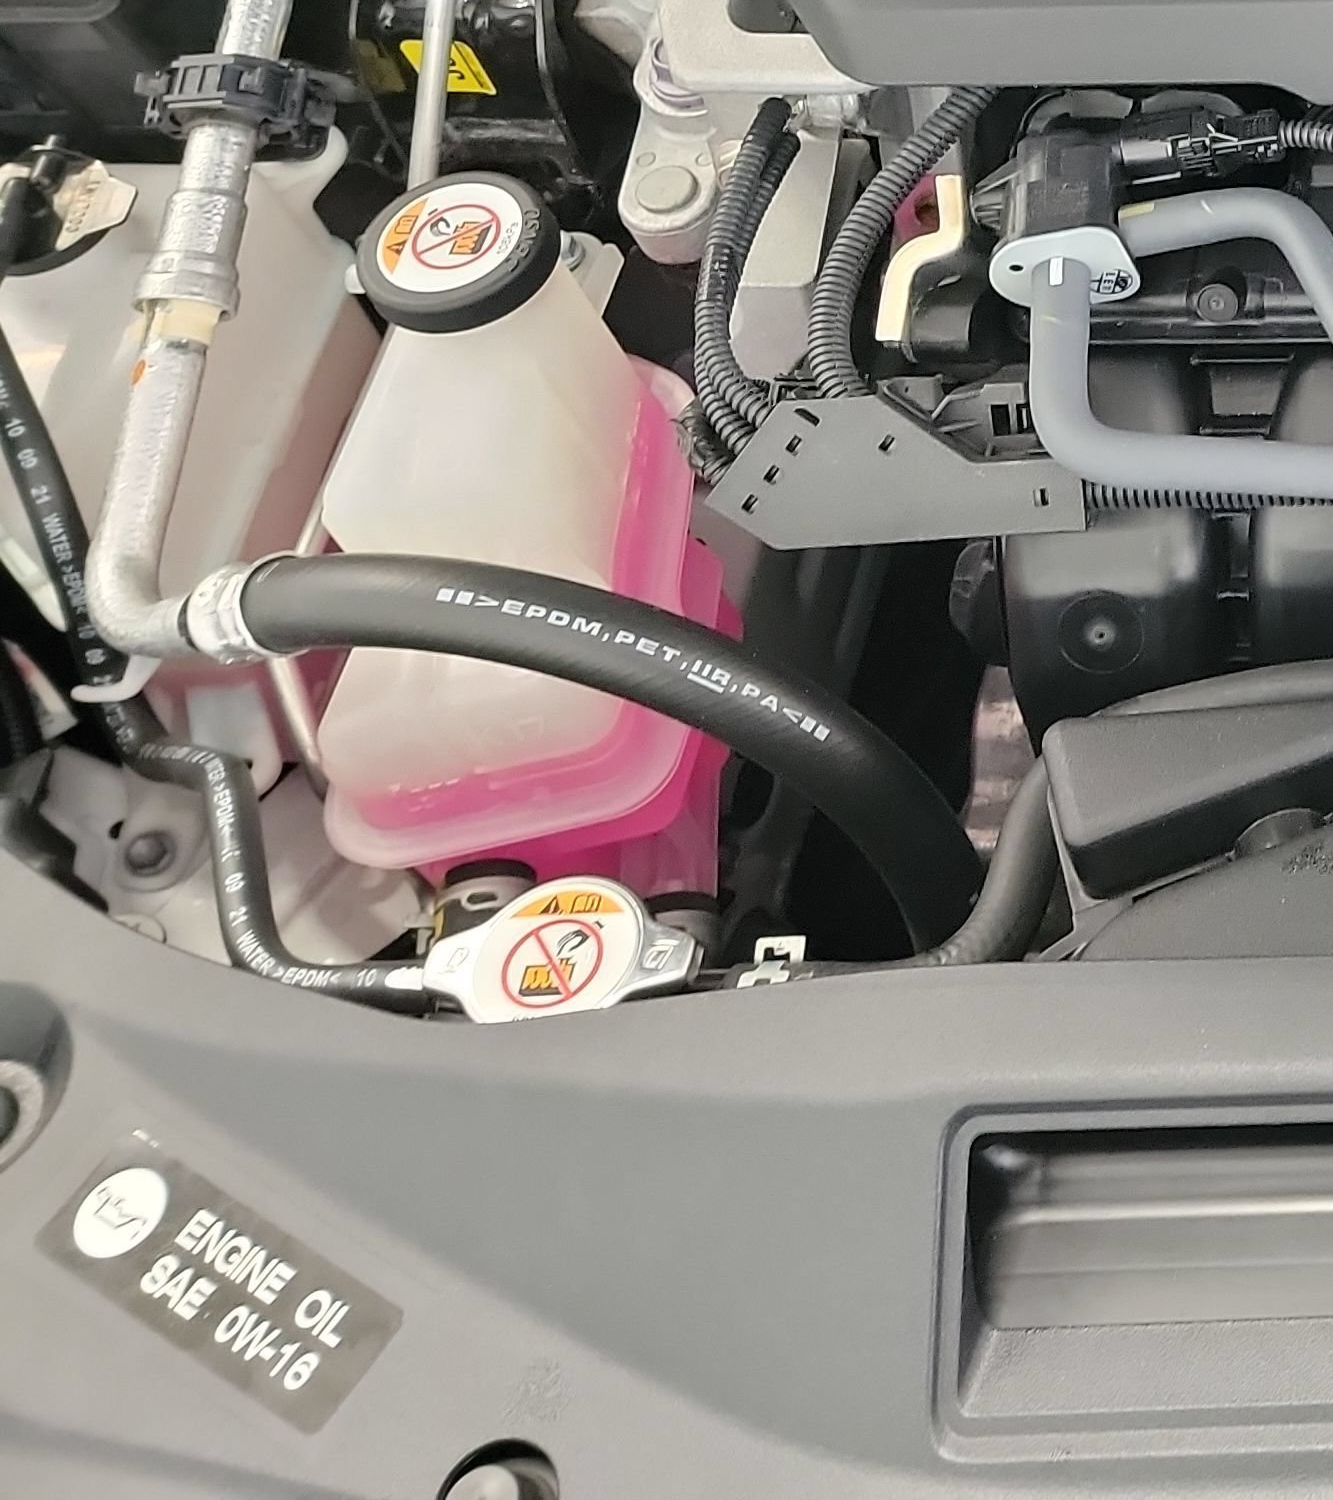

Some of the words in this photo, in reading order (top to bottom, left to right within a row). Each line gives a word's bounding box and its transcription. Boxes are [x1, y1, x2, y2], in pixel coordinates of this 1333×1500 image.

[5, 417, 26, 438] 10
[42, 512, 73, 564] WATER
[236, 928, 276, 976] WATER
[356, 969, 379, 987] 10
[140, 1253, 220, 1322] SAE
[214, 1305, 321, 1390] 0W-16
[174, 1208, 298, 1306] ENGINE
[294, 1289, 351, 1349] OIL
